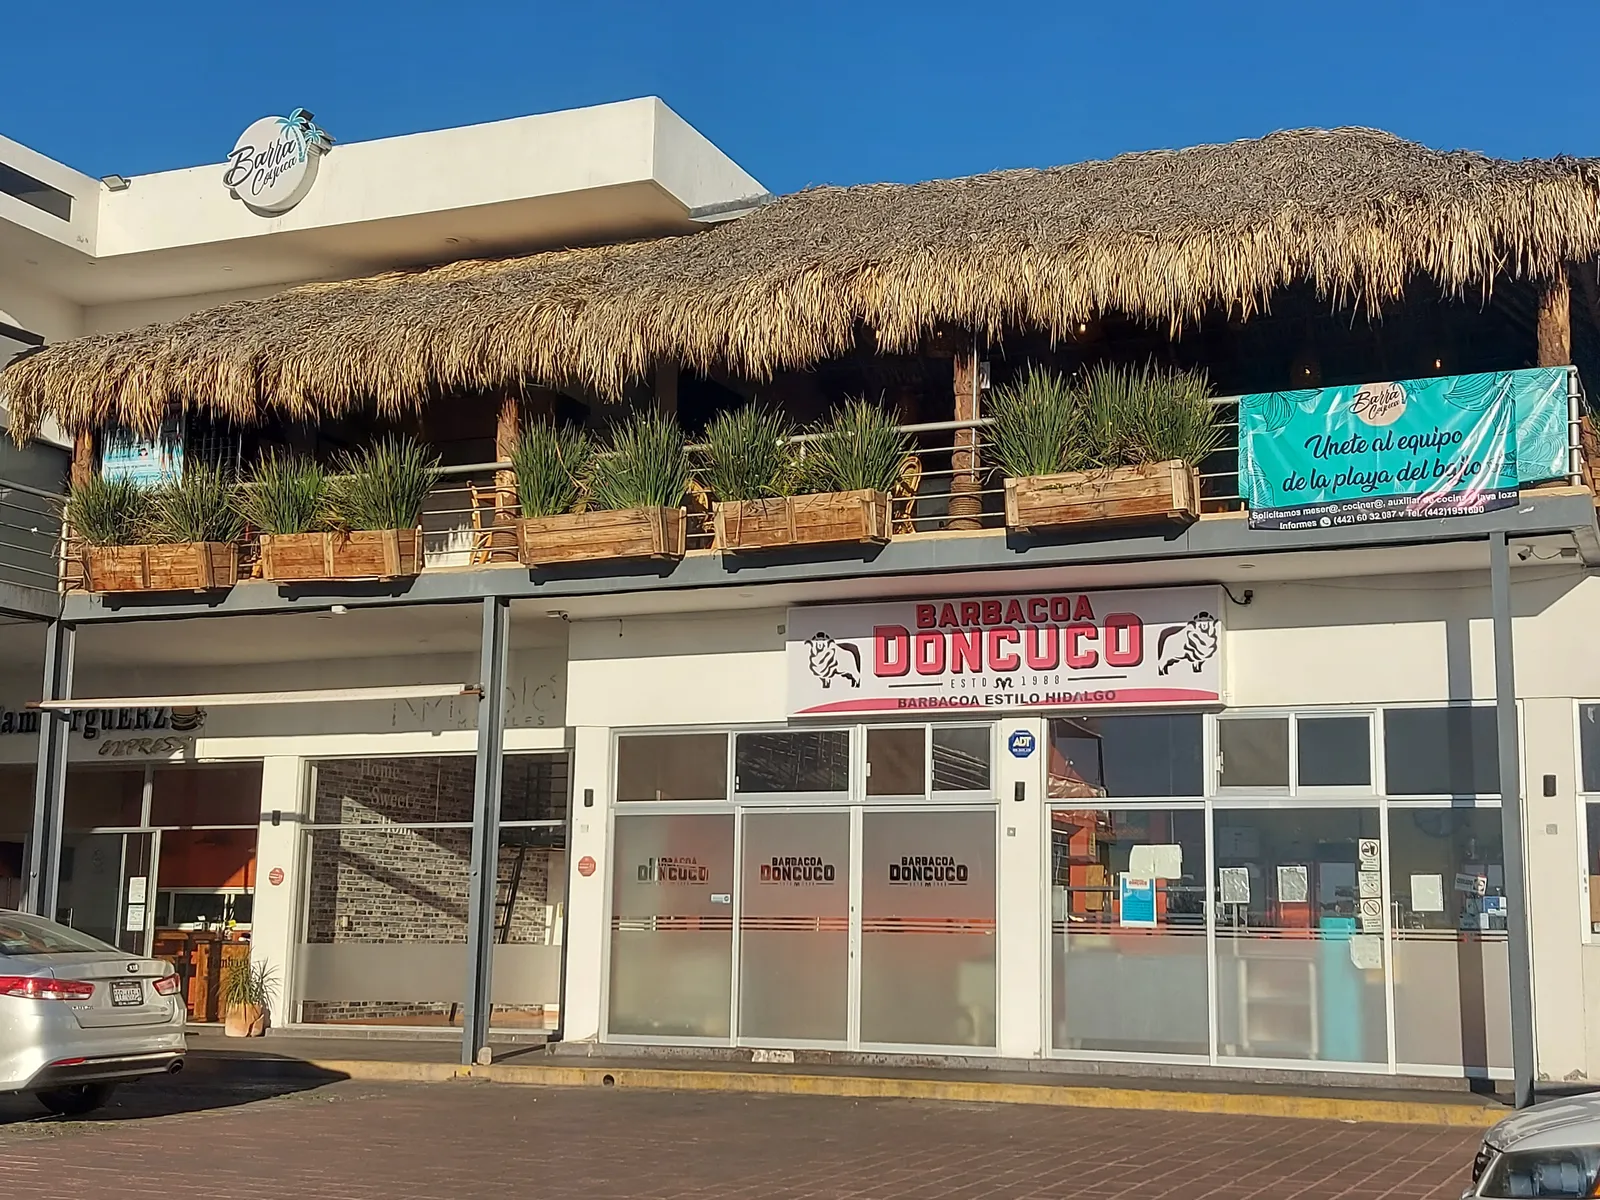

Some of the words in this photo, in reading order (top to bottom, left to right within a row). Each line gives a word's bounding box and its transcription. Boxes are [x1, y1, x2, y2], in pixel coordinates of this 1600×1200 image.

[223, 138, 297, 187] Barra
[1349, 389, 1398, 414] Barra
[1304, 433, 1368, 460] Unete
[1372, 430, 1393, 452] al
[1397, 426, 1462, 455] equipo
[1282, 470, 1307, 492] de
[1310, 468, 1331, 490] la
[1333, 465, 1393, 493] playa
[1397, 460, 1429, 481] del
[1251, 509, 1301, 520] Solicitamos
[1343, 499, 1386, 511] cociner@,
[1388, 496, 1421, 506] auxiliar
[1477, 492, 1497, 502] lava
[1498, 491, 1518, 500] loza
[1280, 519, 1318, 530] Informes
[1333, 514, 1356, 526] (442)
[1356, 513, 1368, 522] 60
[1405, 508, 1422, 517] Tel.
[916, 594, 1095, 629] BARBACOA
[873, 612, 1144, 678] DONCUCO
[1021, 674, 1060, 687] 1988
[898, 694, 980, 709] BARBACOA
[984, 692, 1040, 705] ESTILO
[1045, 689, 1116, 704] HIDALGO
[0, 706, 169, 739] amrguERZ
[1012, 736, 1032, 747] ADT
[760, 864, 835, 882] DONCUCO
[771, 857, 823, 867] BARBACOA
[889, 864, 968, 882] DONCUCO
[901, 856, 955, 867] BARBACOA
